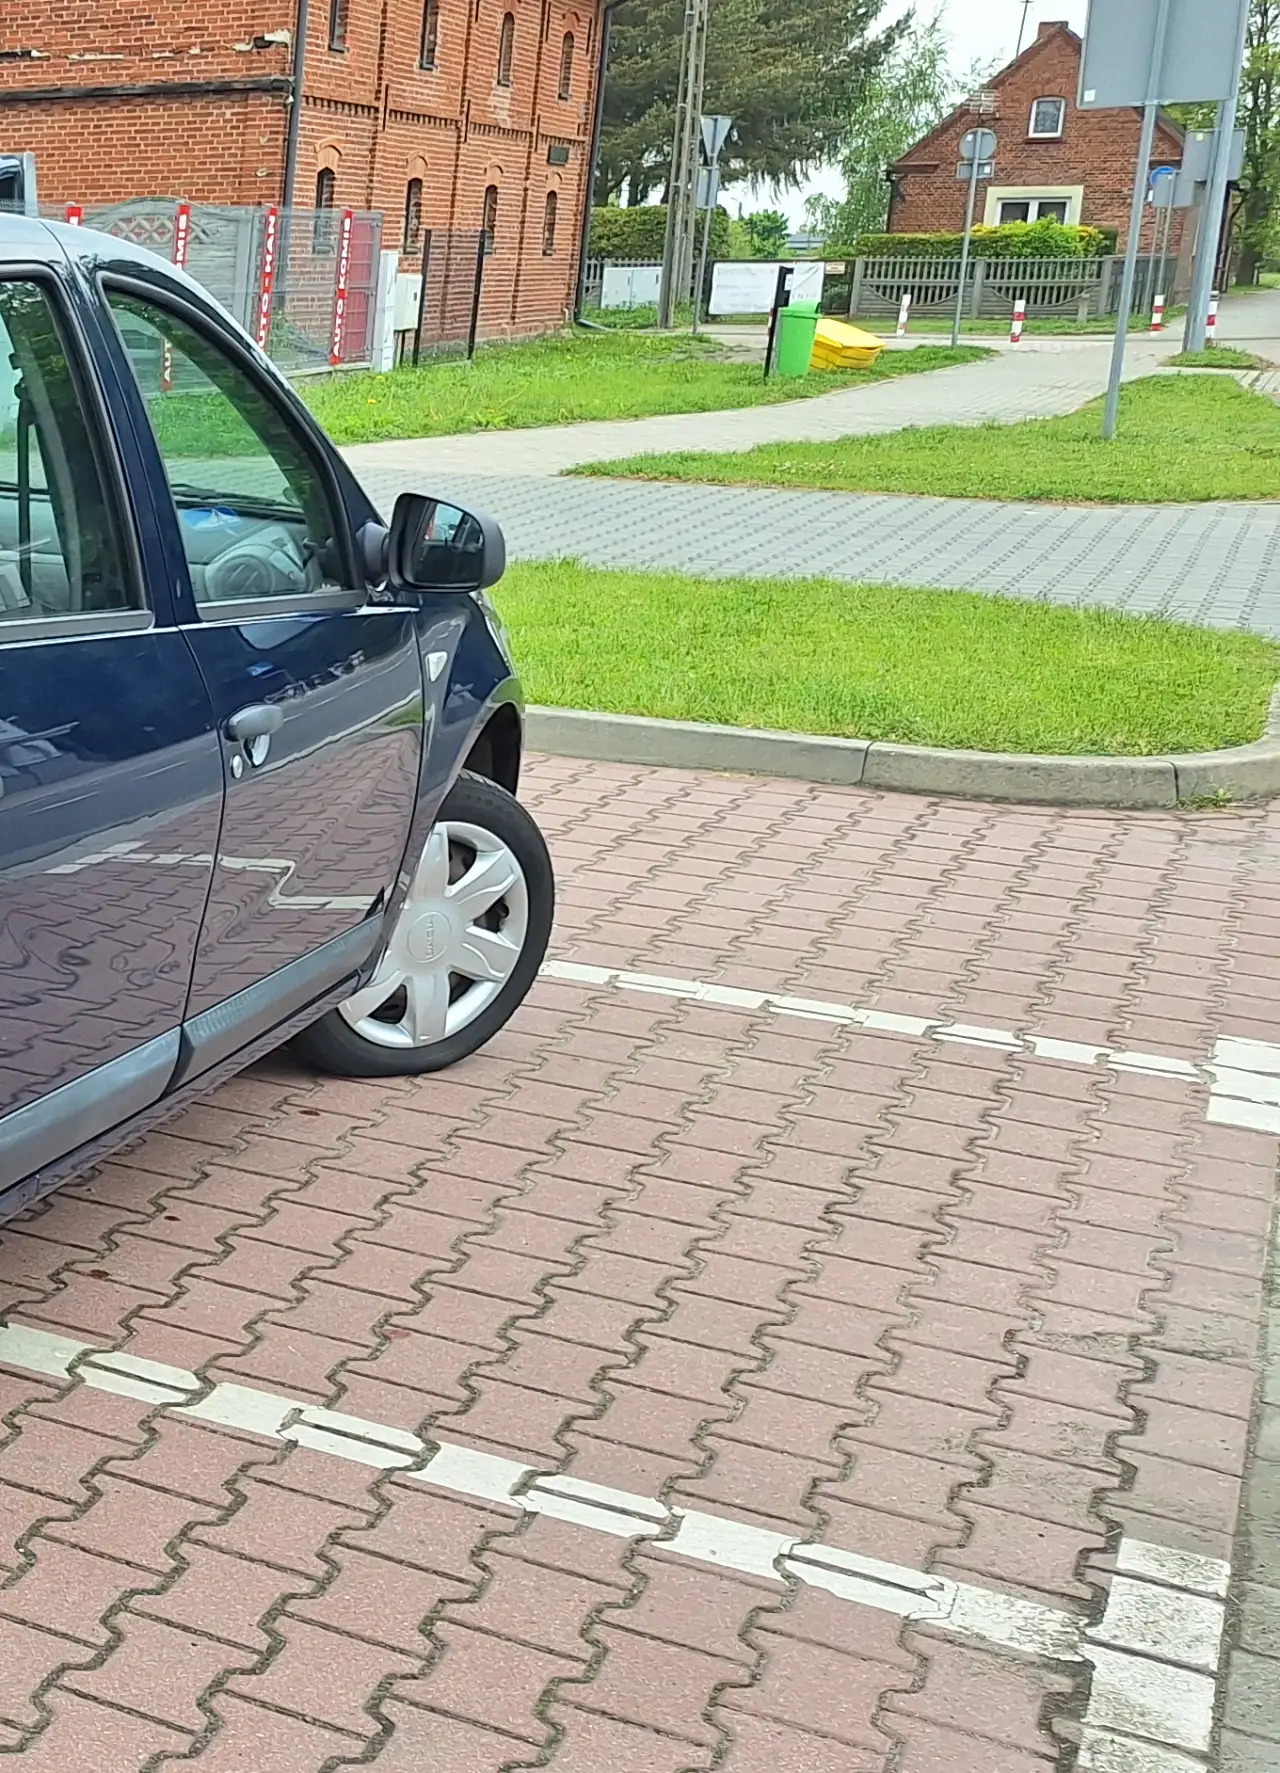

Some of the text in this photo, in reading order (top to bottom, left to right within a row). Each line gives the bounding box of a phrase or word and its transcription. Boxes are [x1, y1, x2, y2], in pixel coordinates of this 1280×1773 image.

[257, 293, 270, 352] UTO
[332, 217, 351, 357] AUTO KOMIS
